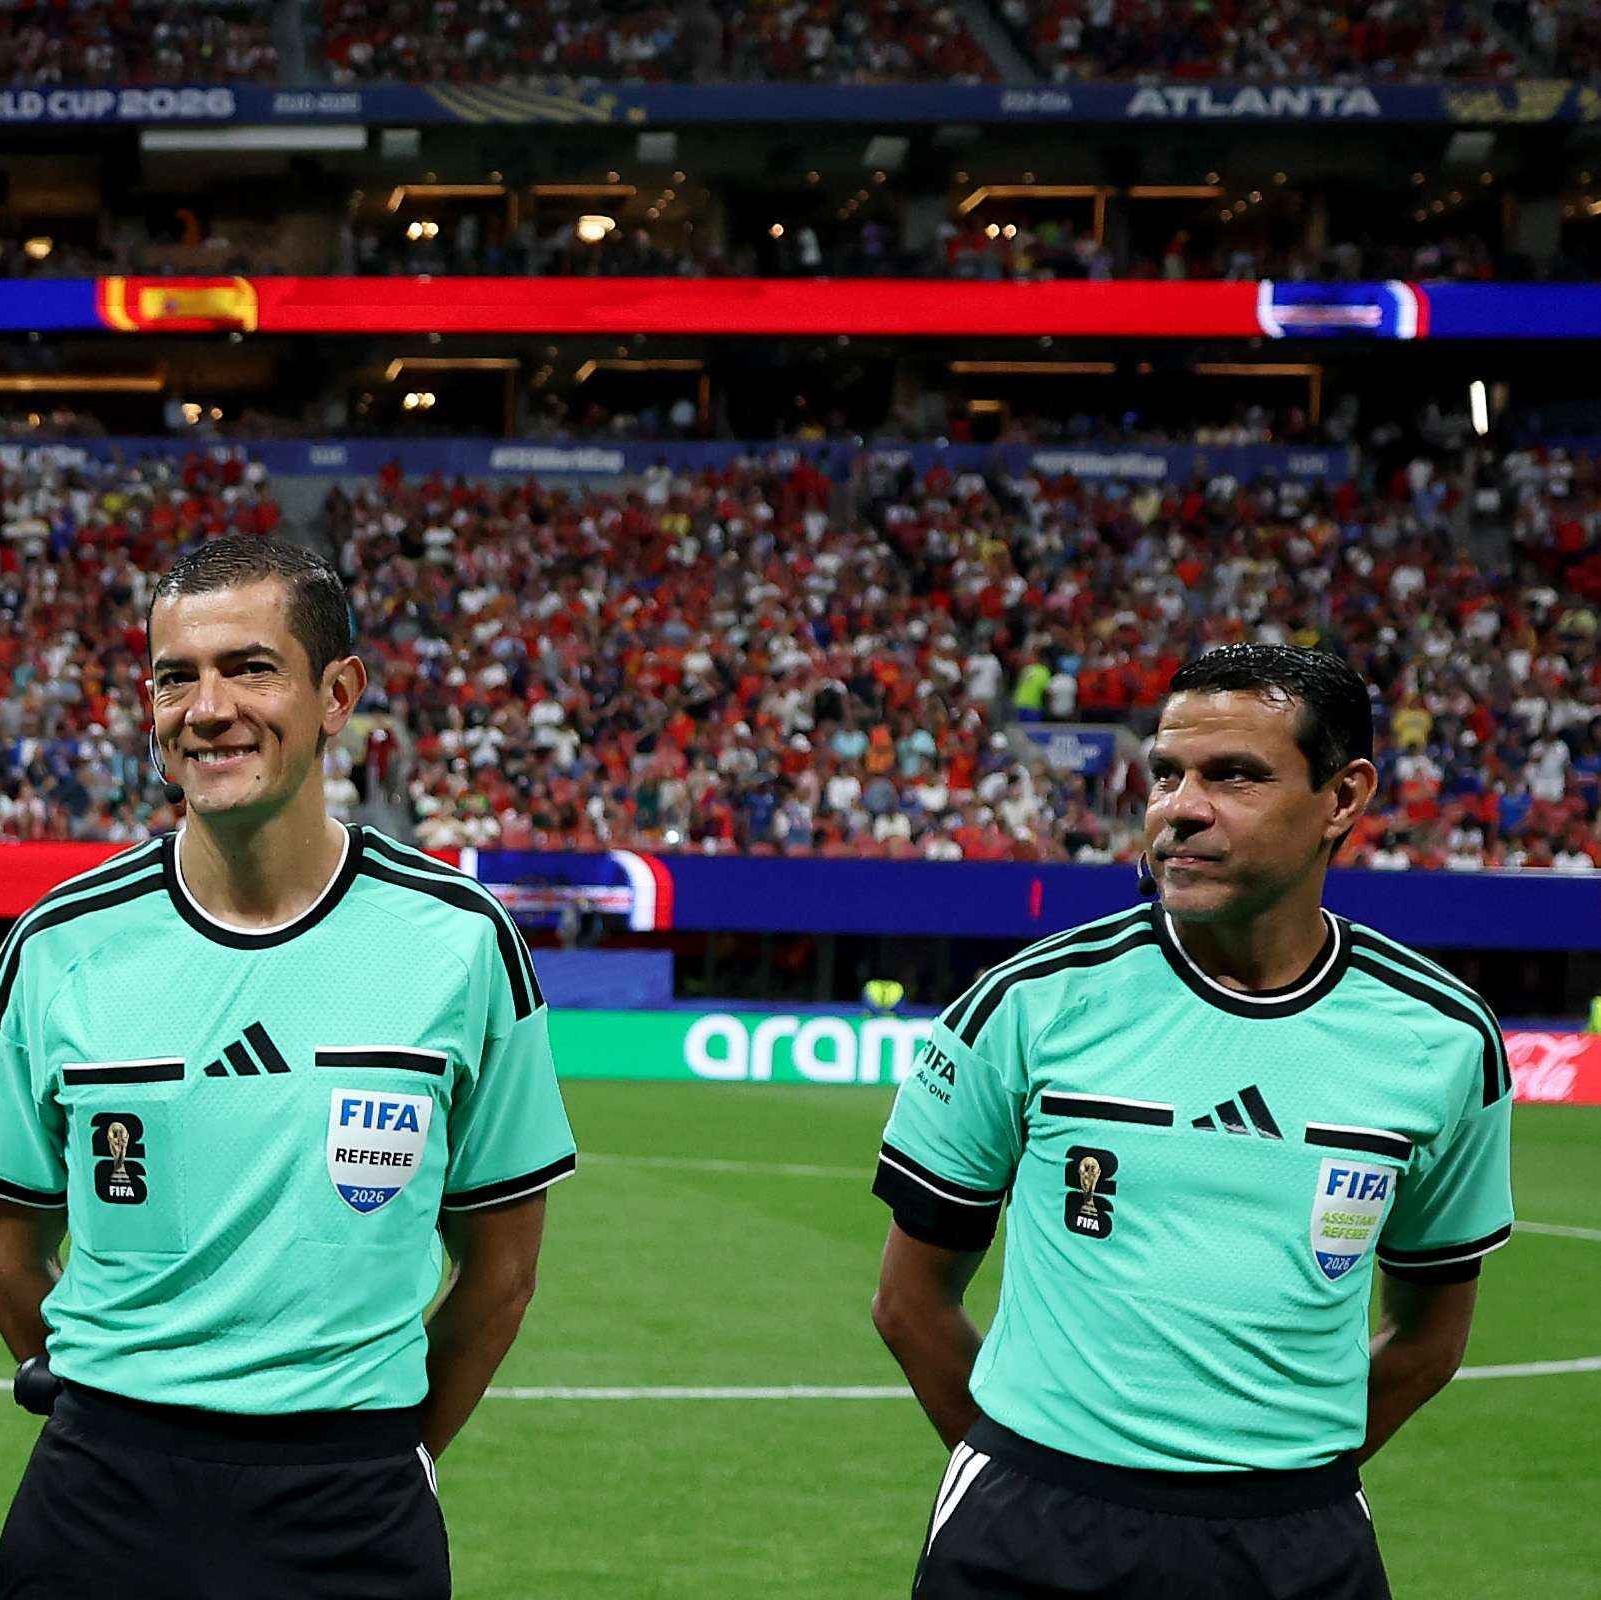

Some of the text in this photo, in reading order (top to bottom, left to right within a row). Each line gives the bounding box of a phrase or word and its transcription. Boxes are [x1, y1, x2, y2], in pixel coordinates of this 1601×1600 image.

[47, 90, 115, 118] CUP
[118, 87, 234, 117] 2026
[1126, 86, 1380, 117] ATLANTA
[684, 1013, 934, 1084] aram
[339, 1099, 419, 1133] FIFA
[335, 1148, 414, 1167] REFEREE
[109, 1185, 135, 1198] FIFA
[349, 1189, 385, 1204] 2026
[1326, 1168, 1389, 1200] FIFA
[1076, 1215, 1100, 1232] FIFA
[1324, 1256, 1351, 1272] 2026
